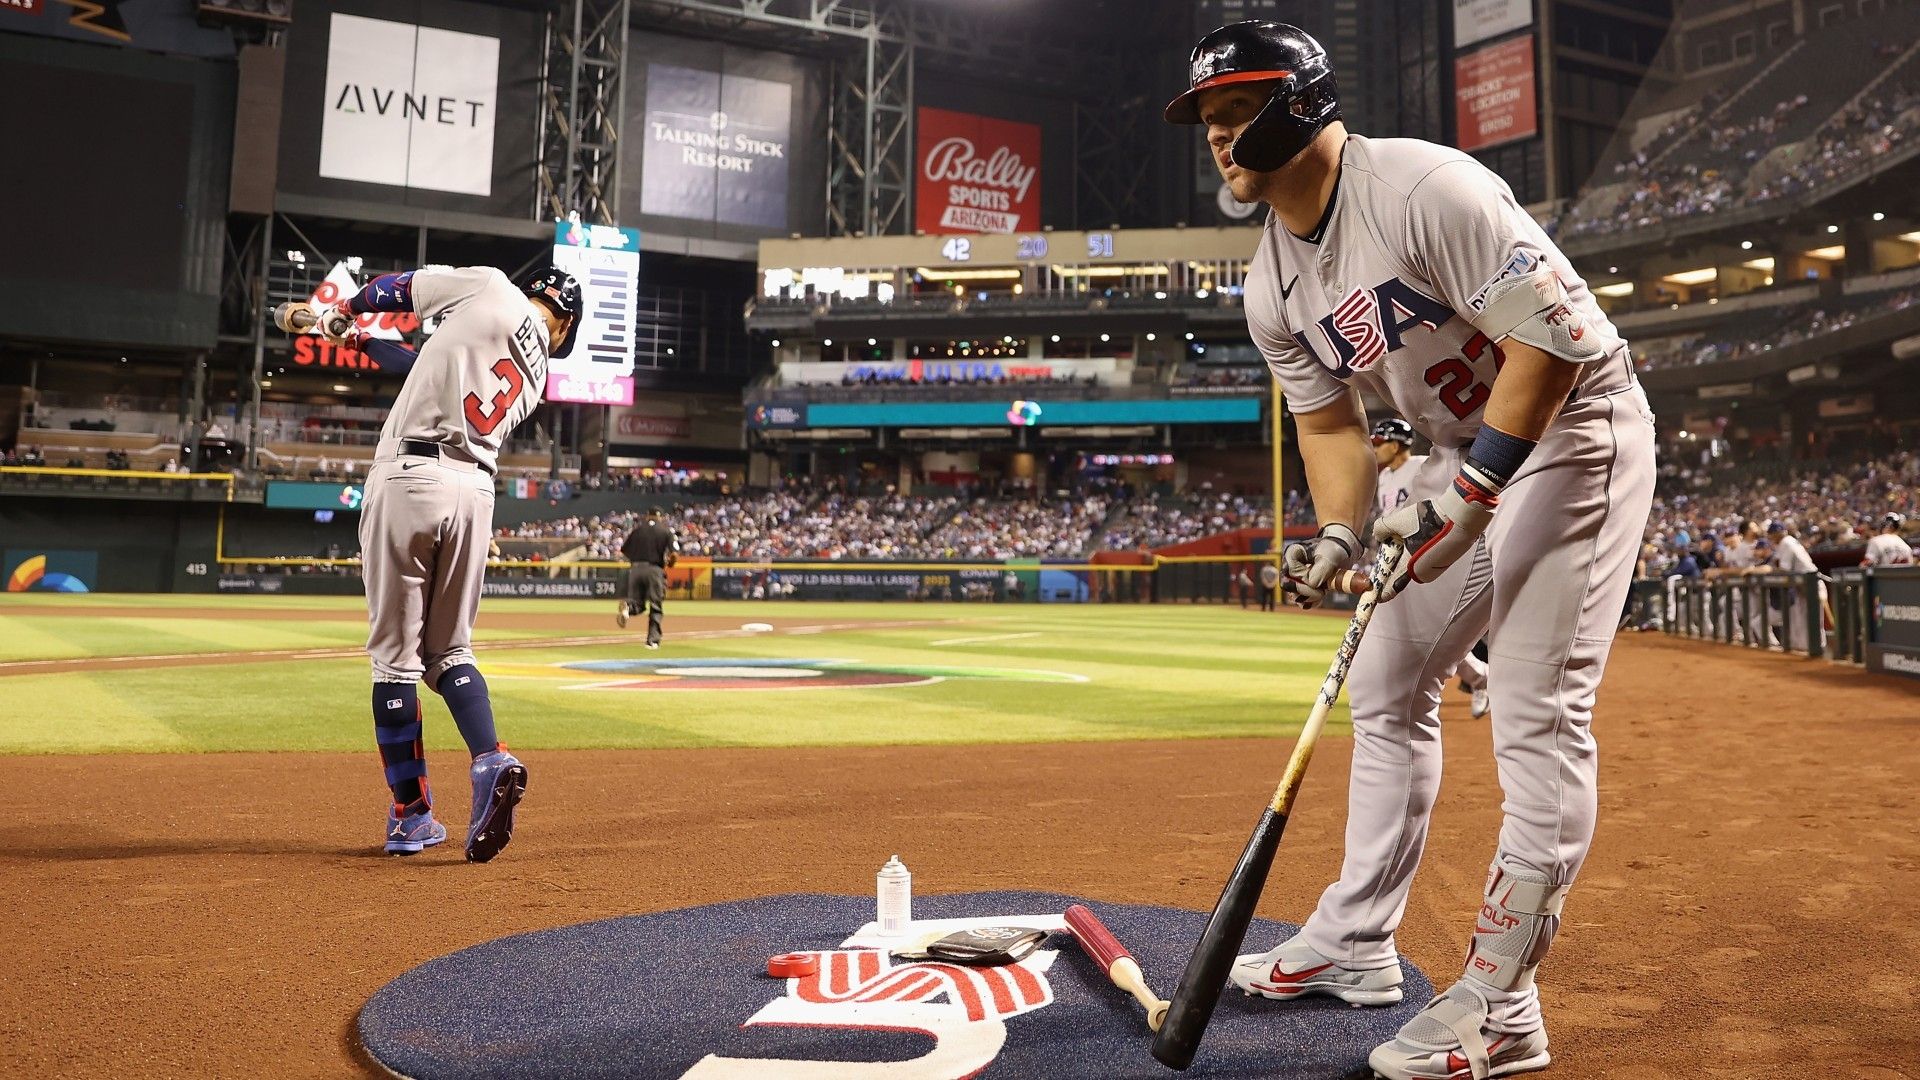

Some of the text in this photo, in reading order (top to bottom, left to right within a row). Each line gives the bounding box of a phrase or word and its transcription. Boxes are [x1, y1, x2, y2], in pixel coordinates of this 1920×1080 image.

[336, 84, 484, 127] AVNET
[734, 133, 783, 158] STICK
[682, 145, 753, 172] RESORT
[925, 137, 1037, 204] Bally
[949, 185, 1010, 212] SPORTS
[950, 208, 1009, 230] ARIZONA
[942, 238, 971, 261] 42
[1017, 235, 1049, 259] 20
[1087, 234, 1114, 257] 51
[547, 275, 557, 284] 3
[1292, 277, 1457, 379] USA
[514, 315, 547, 381] BETTS
[926, 363, 1005, 381] ULTRA
[1424, 330, 1506, 421] 27
[463, 358, 523, 436] 3
[185, 563, 208, 576] 413
[518, 583, 535, 595] OF
[535, 583, 593, 597] BASEBALL
[595, 582, 616, 595] 374
[1474, 956, 1498, 974] 27
